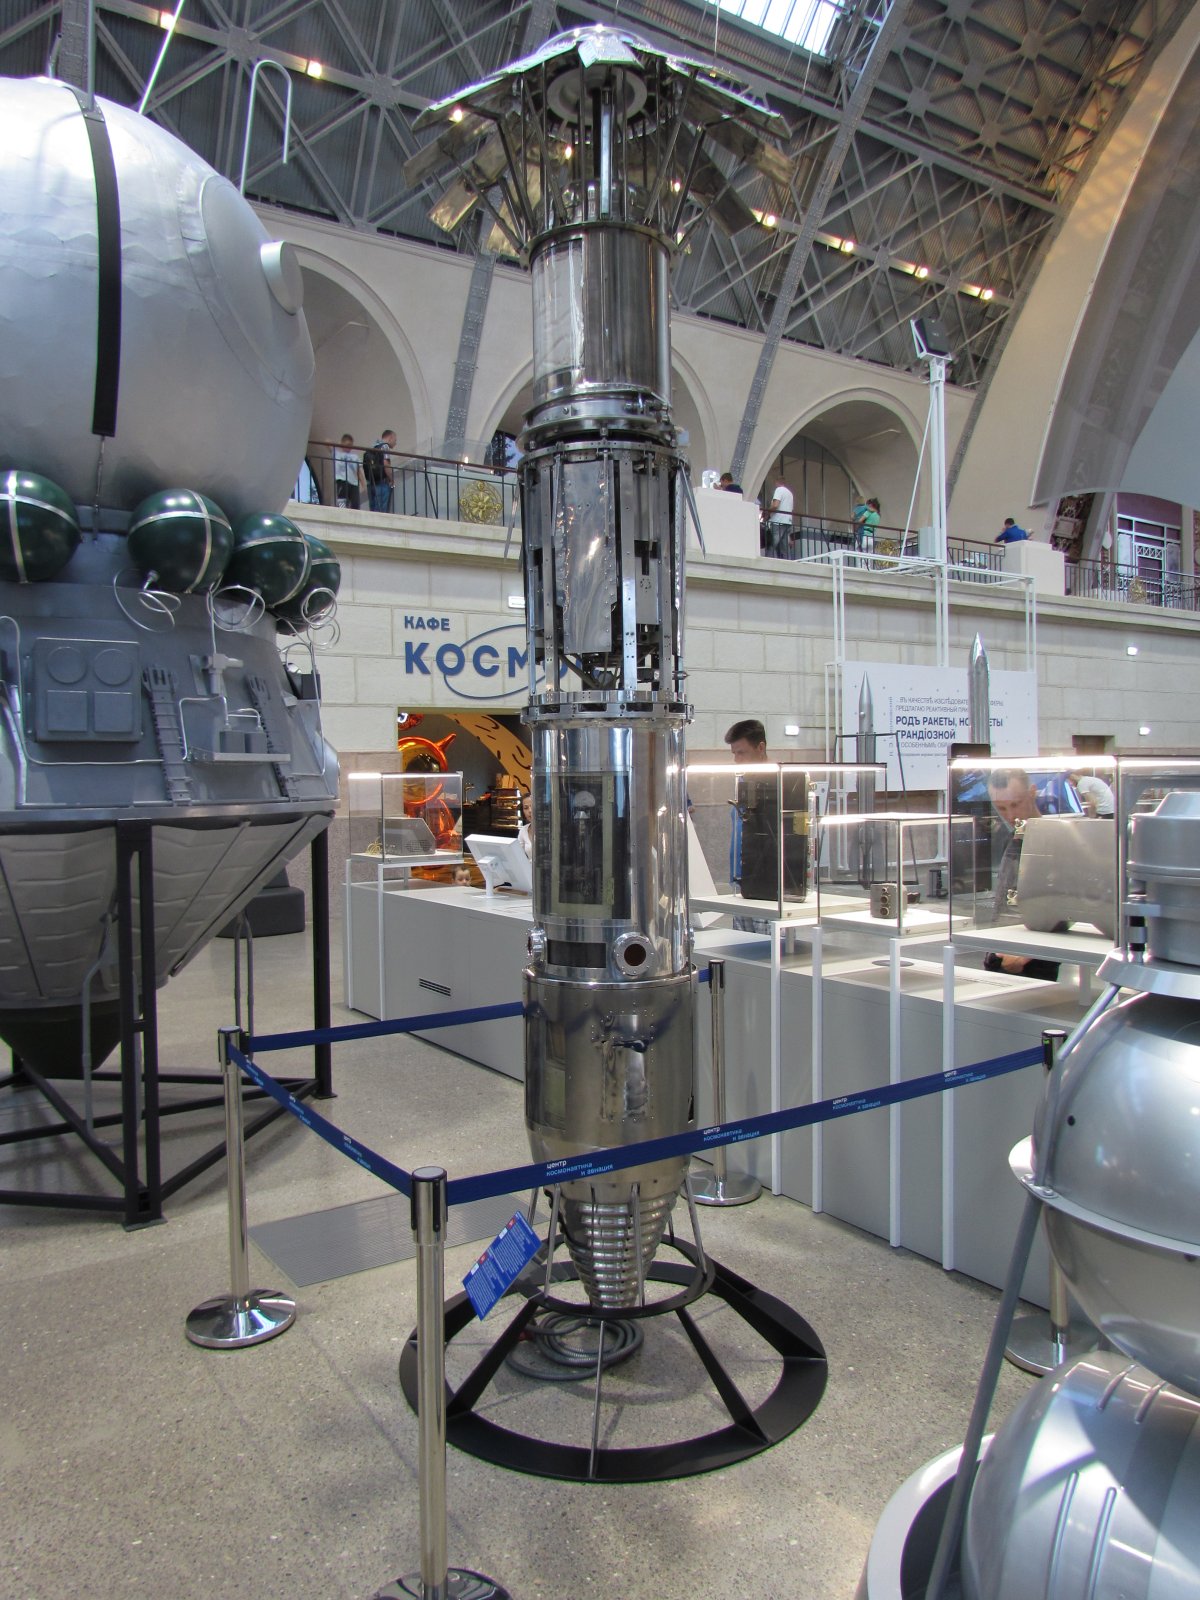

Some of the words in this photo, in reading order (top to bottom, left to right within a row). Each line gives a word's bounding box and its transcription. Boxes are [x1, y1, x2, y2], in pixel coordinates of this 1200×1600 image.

[404, 615, 450, 631] КАФЕ
[404, 641, 601, 679] КОСМ
[896, 716, 921, 727] РОДЪ
[922, 717, 958, 728] РАКЕТЫ,
[546, 1160, 567, 1169] центр
[546, 1162, 593, 1176] космонавтика
